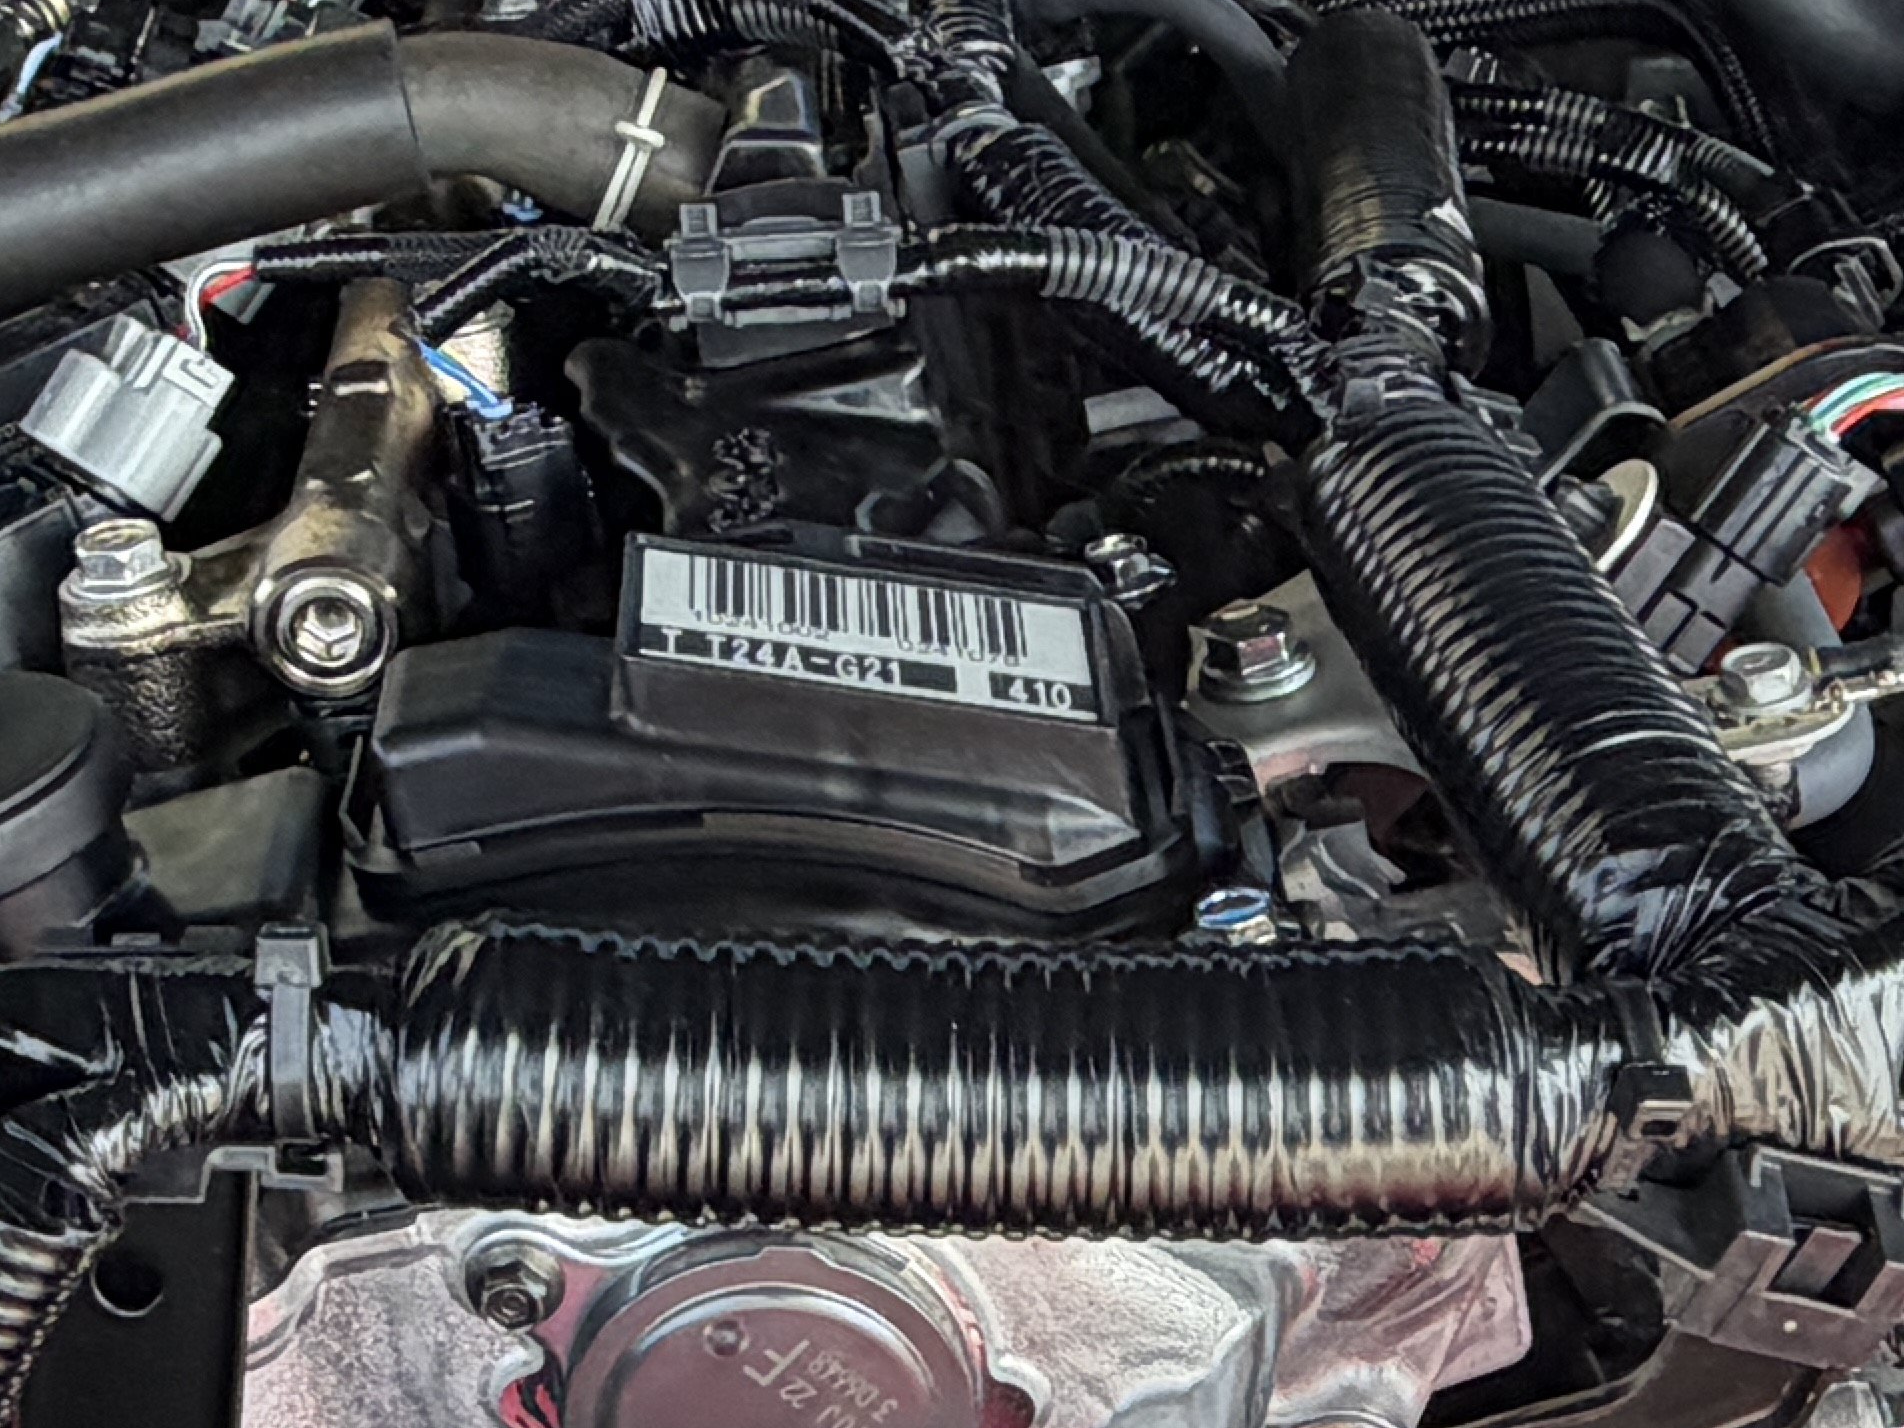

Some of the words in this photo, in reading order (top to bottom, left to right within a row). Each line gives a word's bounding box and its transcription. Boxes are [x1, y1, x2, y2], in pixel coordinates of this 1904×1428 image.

[661, 628, 684, 656] T
[705, 633, 901, 685] T24A-G21
[1007, 681, 1073, 711] 410
